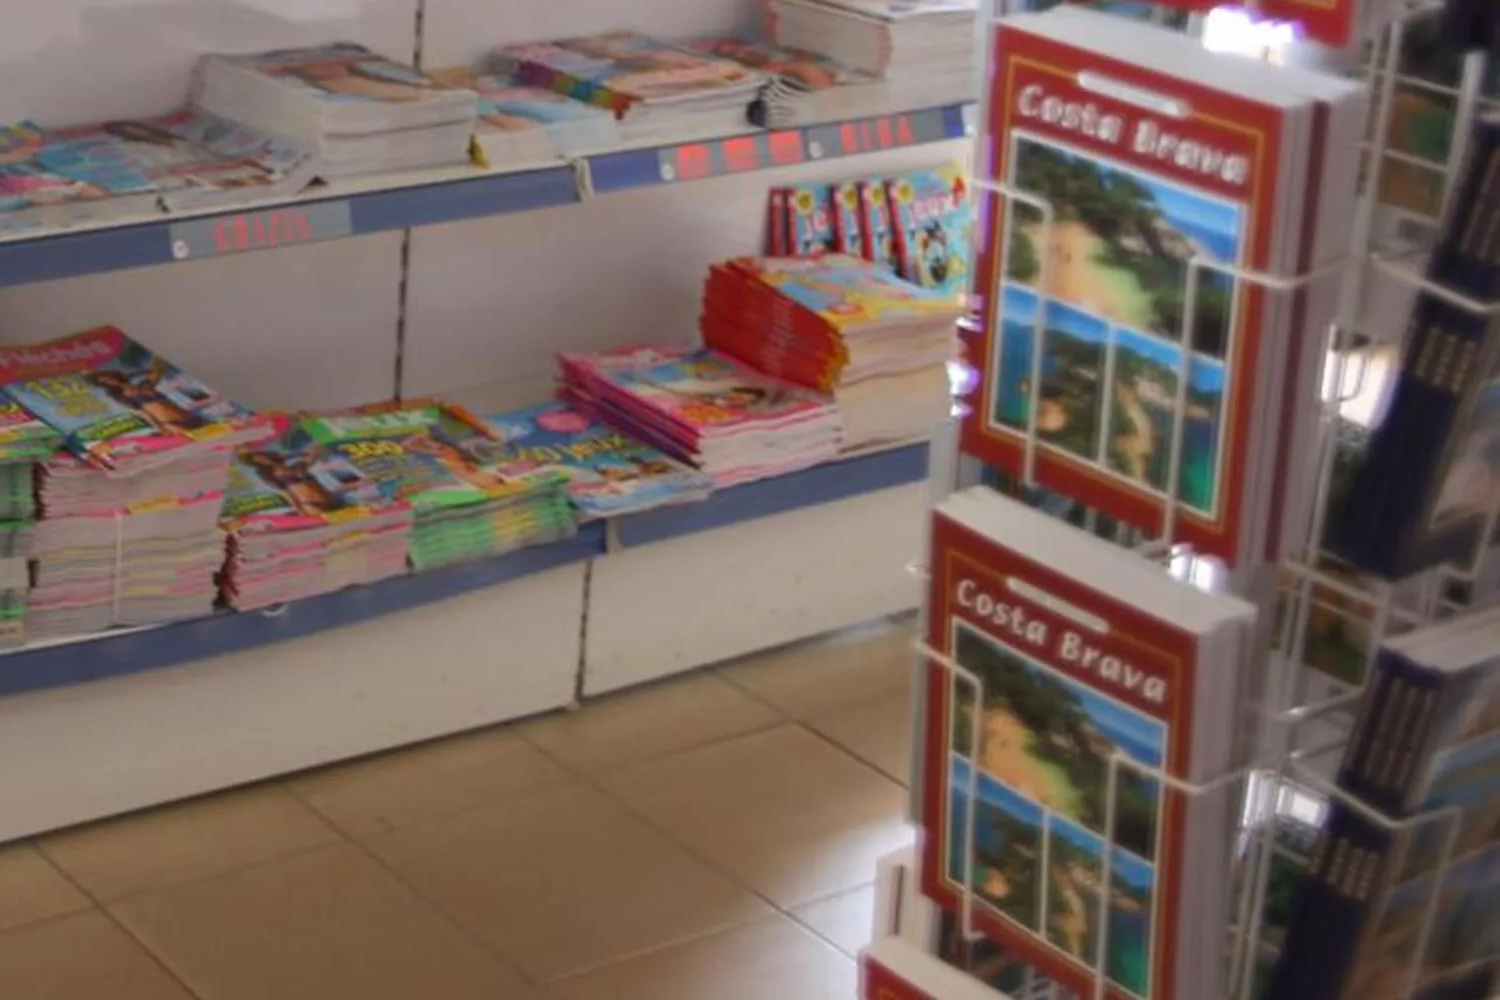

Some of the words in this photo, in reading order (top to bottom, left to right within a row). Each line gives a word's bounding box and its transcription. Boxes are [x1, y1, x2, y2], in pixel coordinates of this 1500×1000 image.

[1017, 84, 1125, 142] Costa
[1133, 119, 1251, 187] Brava
[956, 577, 1047, 648] Costa
[1058, 630, 1169, 704] Brava
